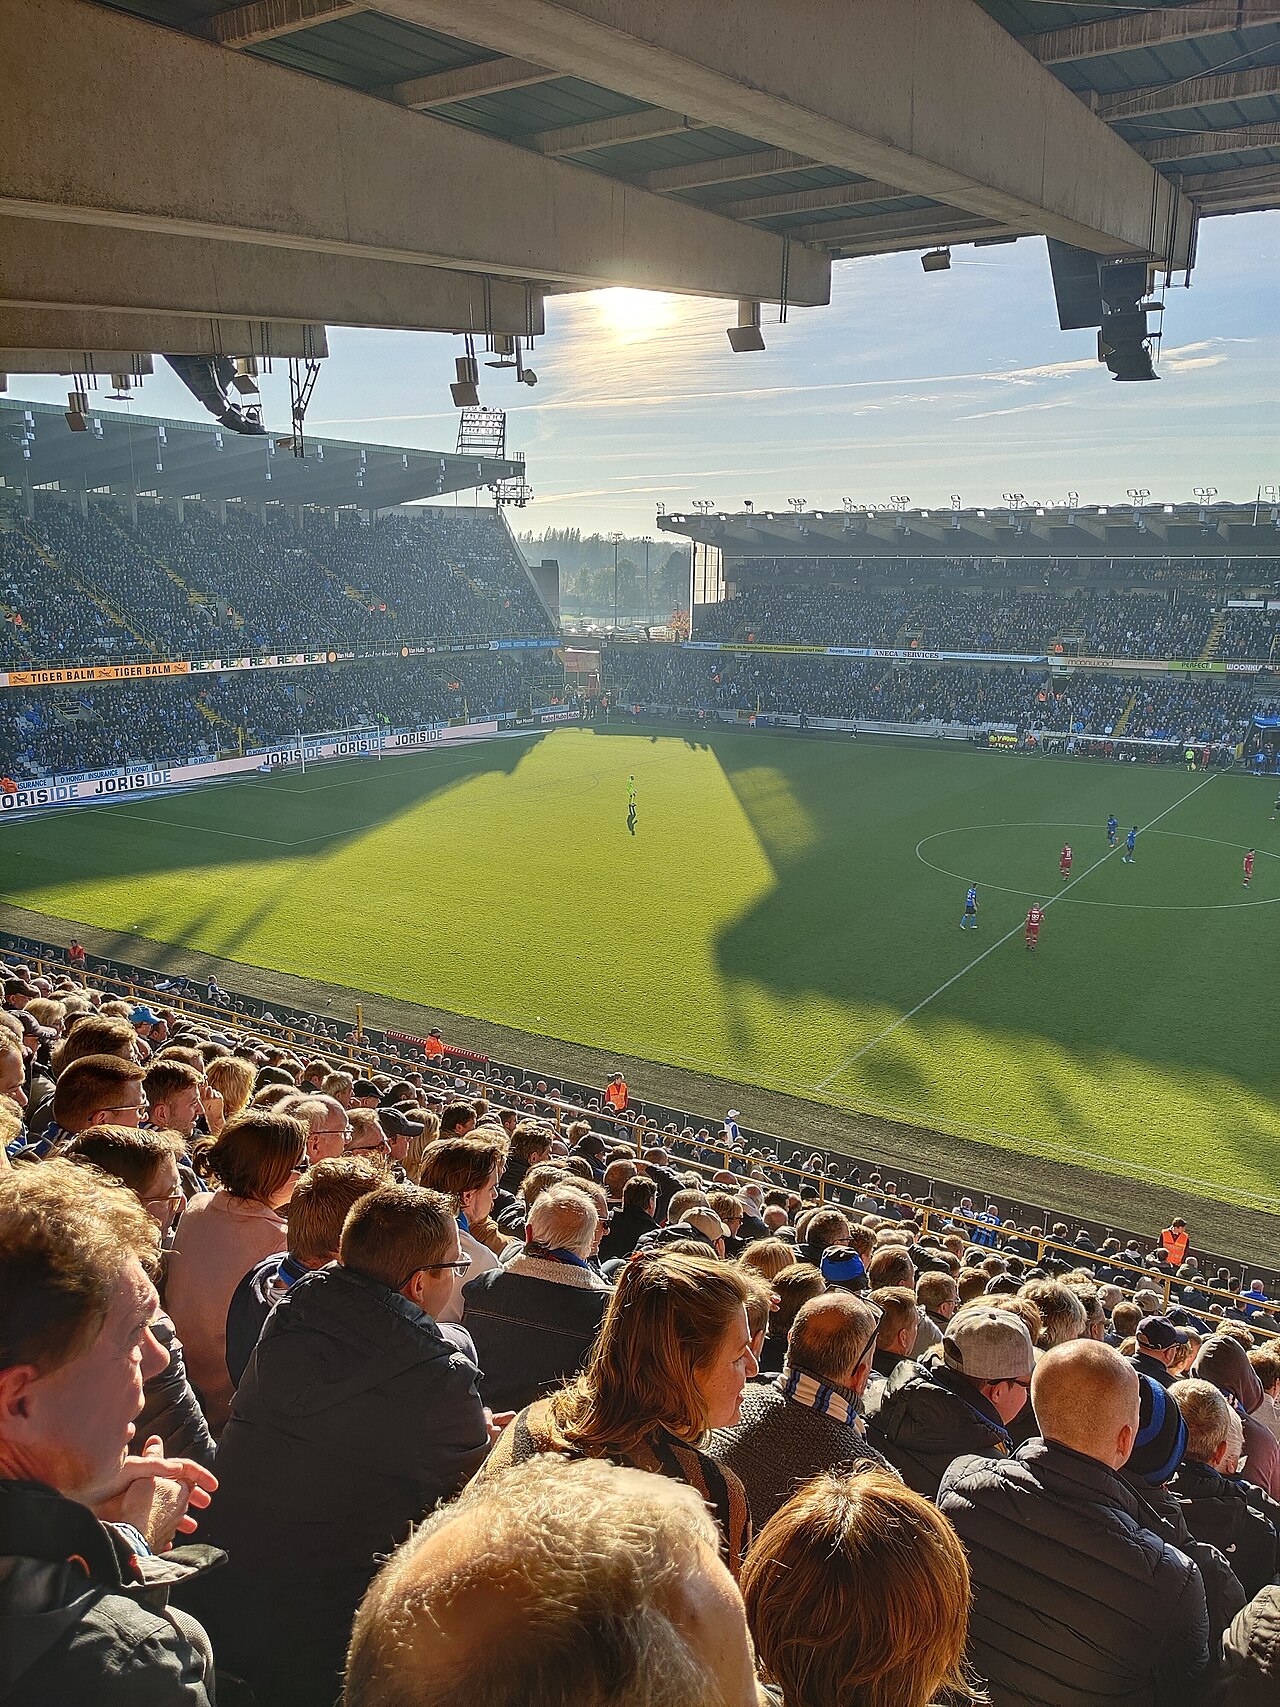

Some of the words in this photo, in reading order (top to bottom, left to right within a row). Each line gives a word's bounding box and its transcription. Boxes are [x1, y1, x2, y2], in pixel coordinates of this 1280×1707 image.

[191, 661, 216, 671] REX
[221, 658, 245, 668] REX
[250, 656, 272, 666] REX
[277, 655, 299, 665] REX
[303, 653, 325, 662] REX
[31, 673, 63, 682] TIGER
[67, 670, 95, 680] BALM
[114, 667, 142, 677] TIGER
[145, 665, 171, 674] BALM
[66, 774, 86, 783] HONDT
[88, 770, 119, 780] INSURANCE
[132, 765, 150, 773] HONDT
[1, 784, 80, 809] ORISIDE
